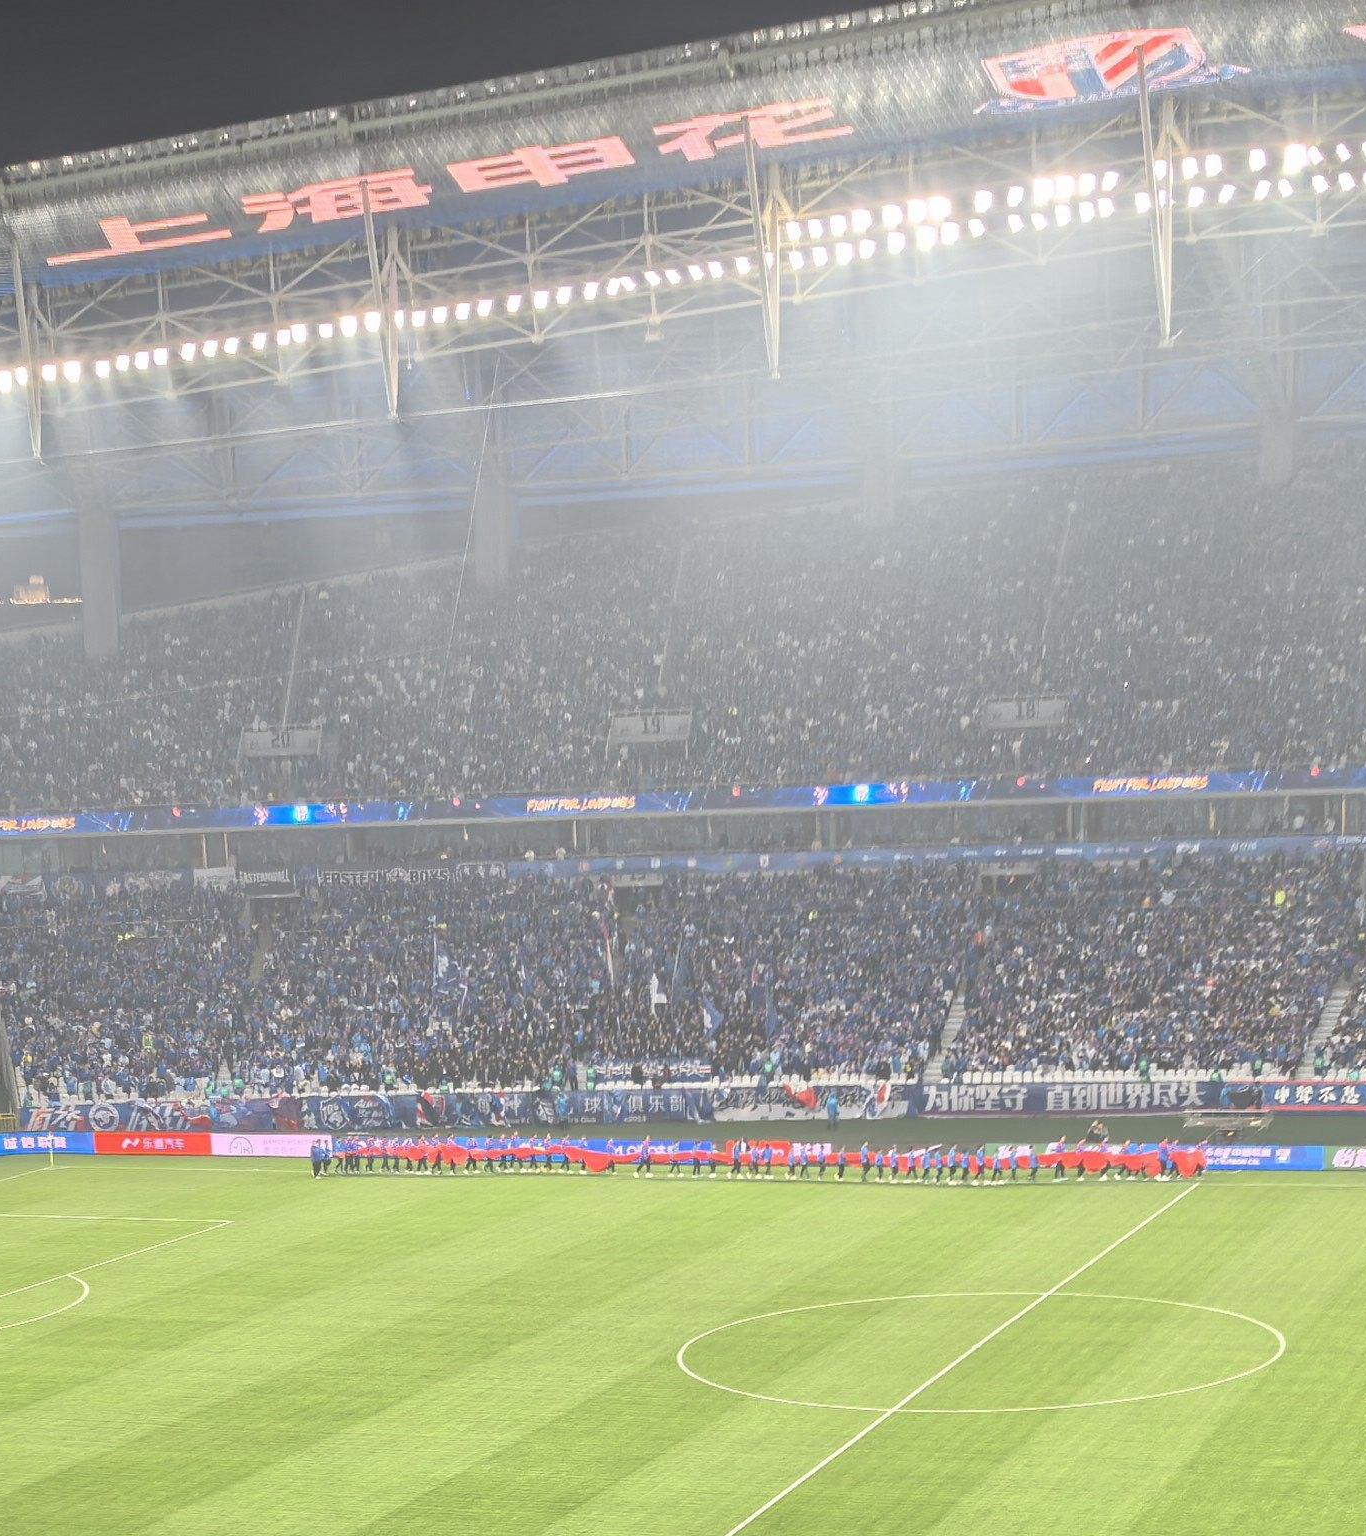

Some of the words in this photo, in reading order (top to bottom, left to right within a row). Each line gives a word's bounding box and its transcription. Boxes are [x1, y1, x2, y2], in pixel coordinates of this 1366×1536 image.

[46, 98, 854, 267] 上海申花
[924, 1084, 1029, 1111] 为你坚守
[1044, 1081, 1206, 1111] 直到世界尽头
